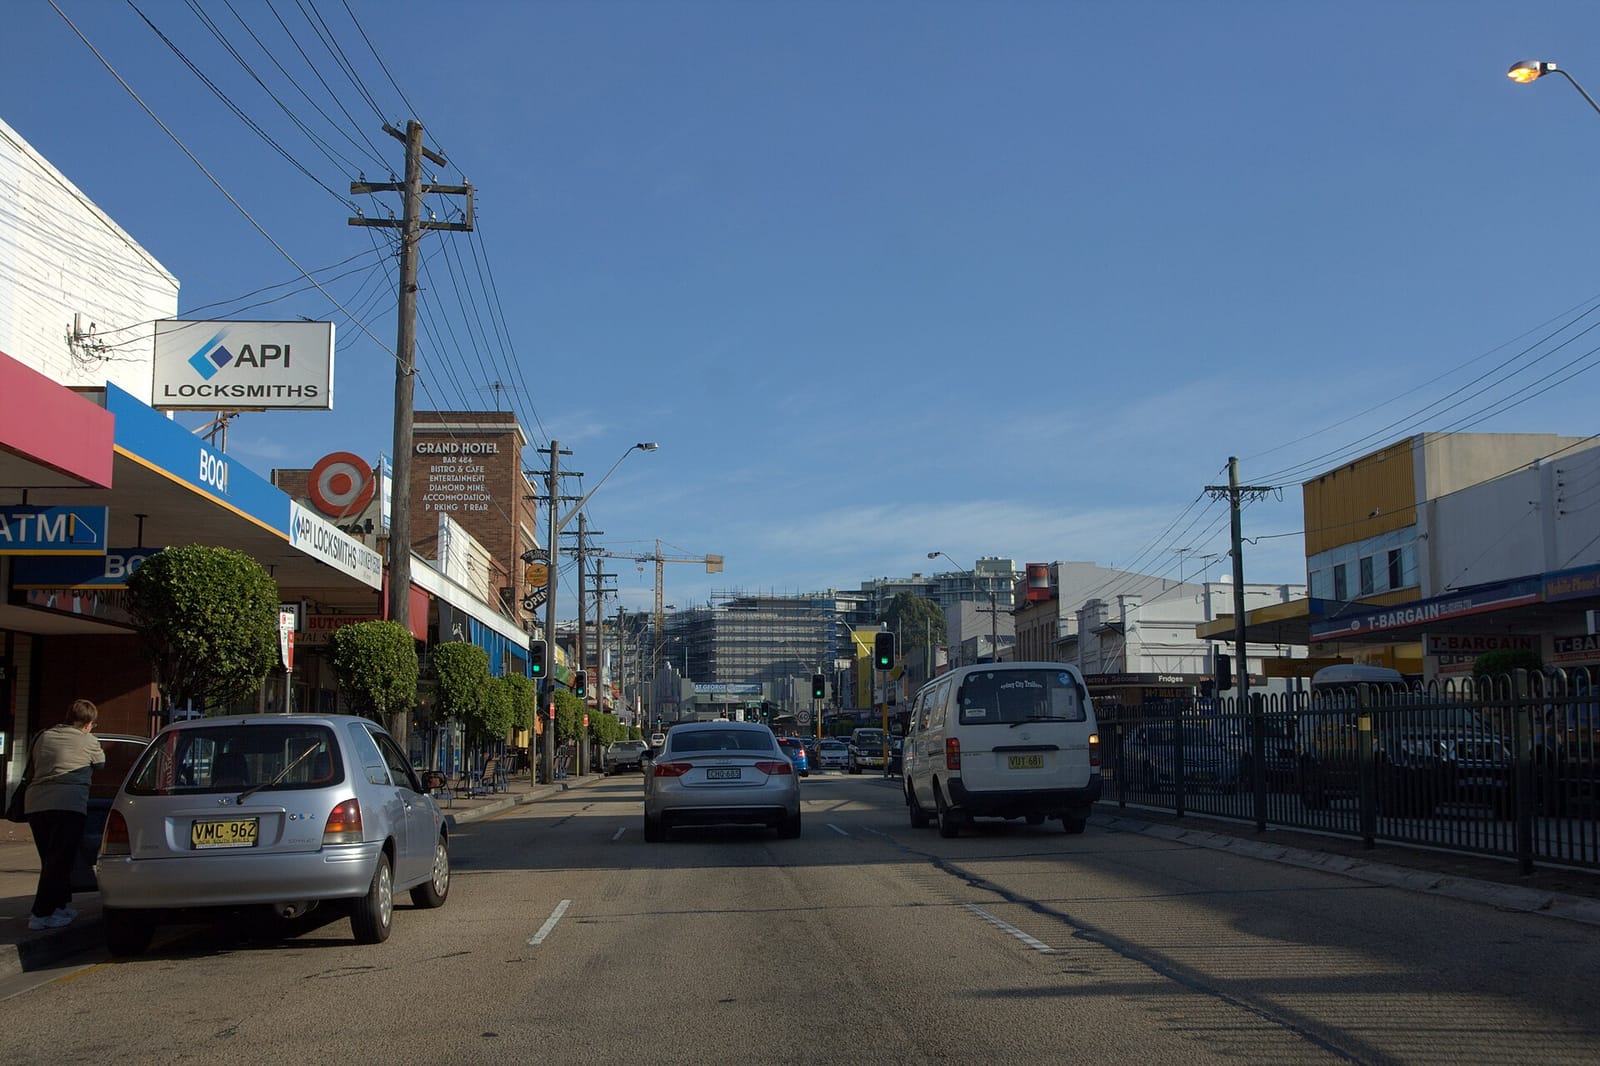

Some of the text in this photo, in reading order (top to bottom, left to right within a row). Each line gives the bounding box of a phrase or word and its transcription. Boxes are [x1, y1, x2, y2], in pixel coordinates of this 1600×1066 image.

[234, 344, 291, 368] API
[164, 384, 318, 398] LOCKSMITHS
[416, 442, 499, 454] GRAND HOTEL
[442, 456, 457, 464] BAR
[200, 448, 225, 492] BOQ
[430, 465, 486, 473] BISTRO & CAFE
[429, 475, 486, 483] ENTERTAINMENT
[429, 484, 486, 492] DIAMOND MINE
[422, 494, 491, 502] ACCOMMODATION
[299, 516, 313, 544] API
[313, 523, 357, 570] LOCKSMITHS
[524, 590, 549, 610] OPEN
[1367, 603, 1440, 631] T-BARGAIN
[1431, 637, 1532, 650] T-BARGAIN
[1158, 675, 1184, 685] Fridges
